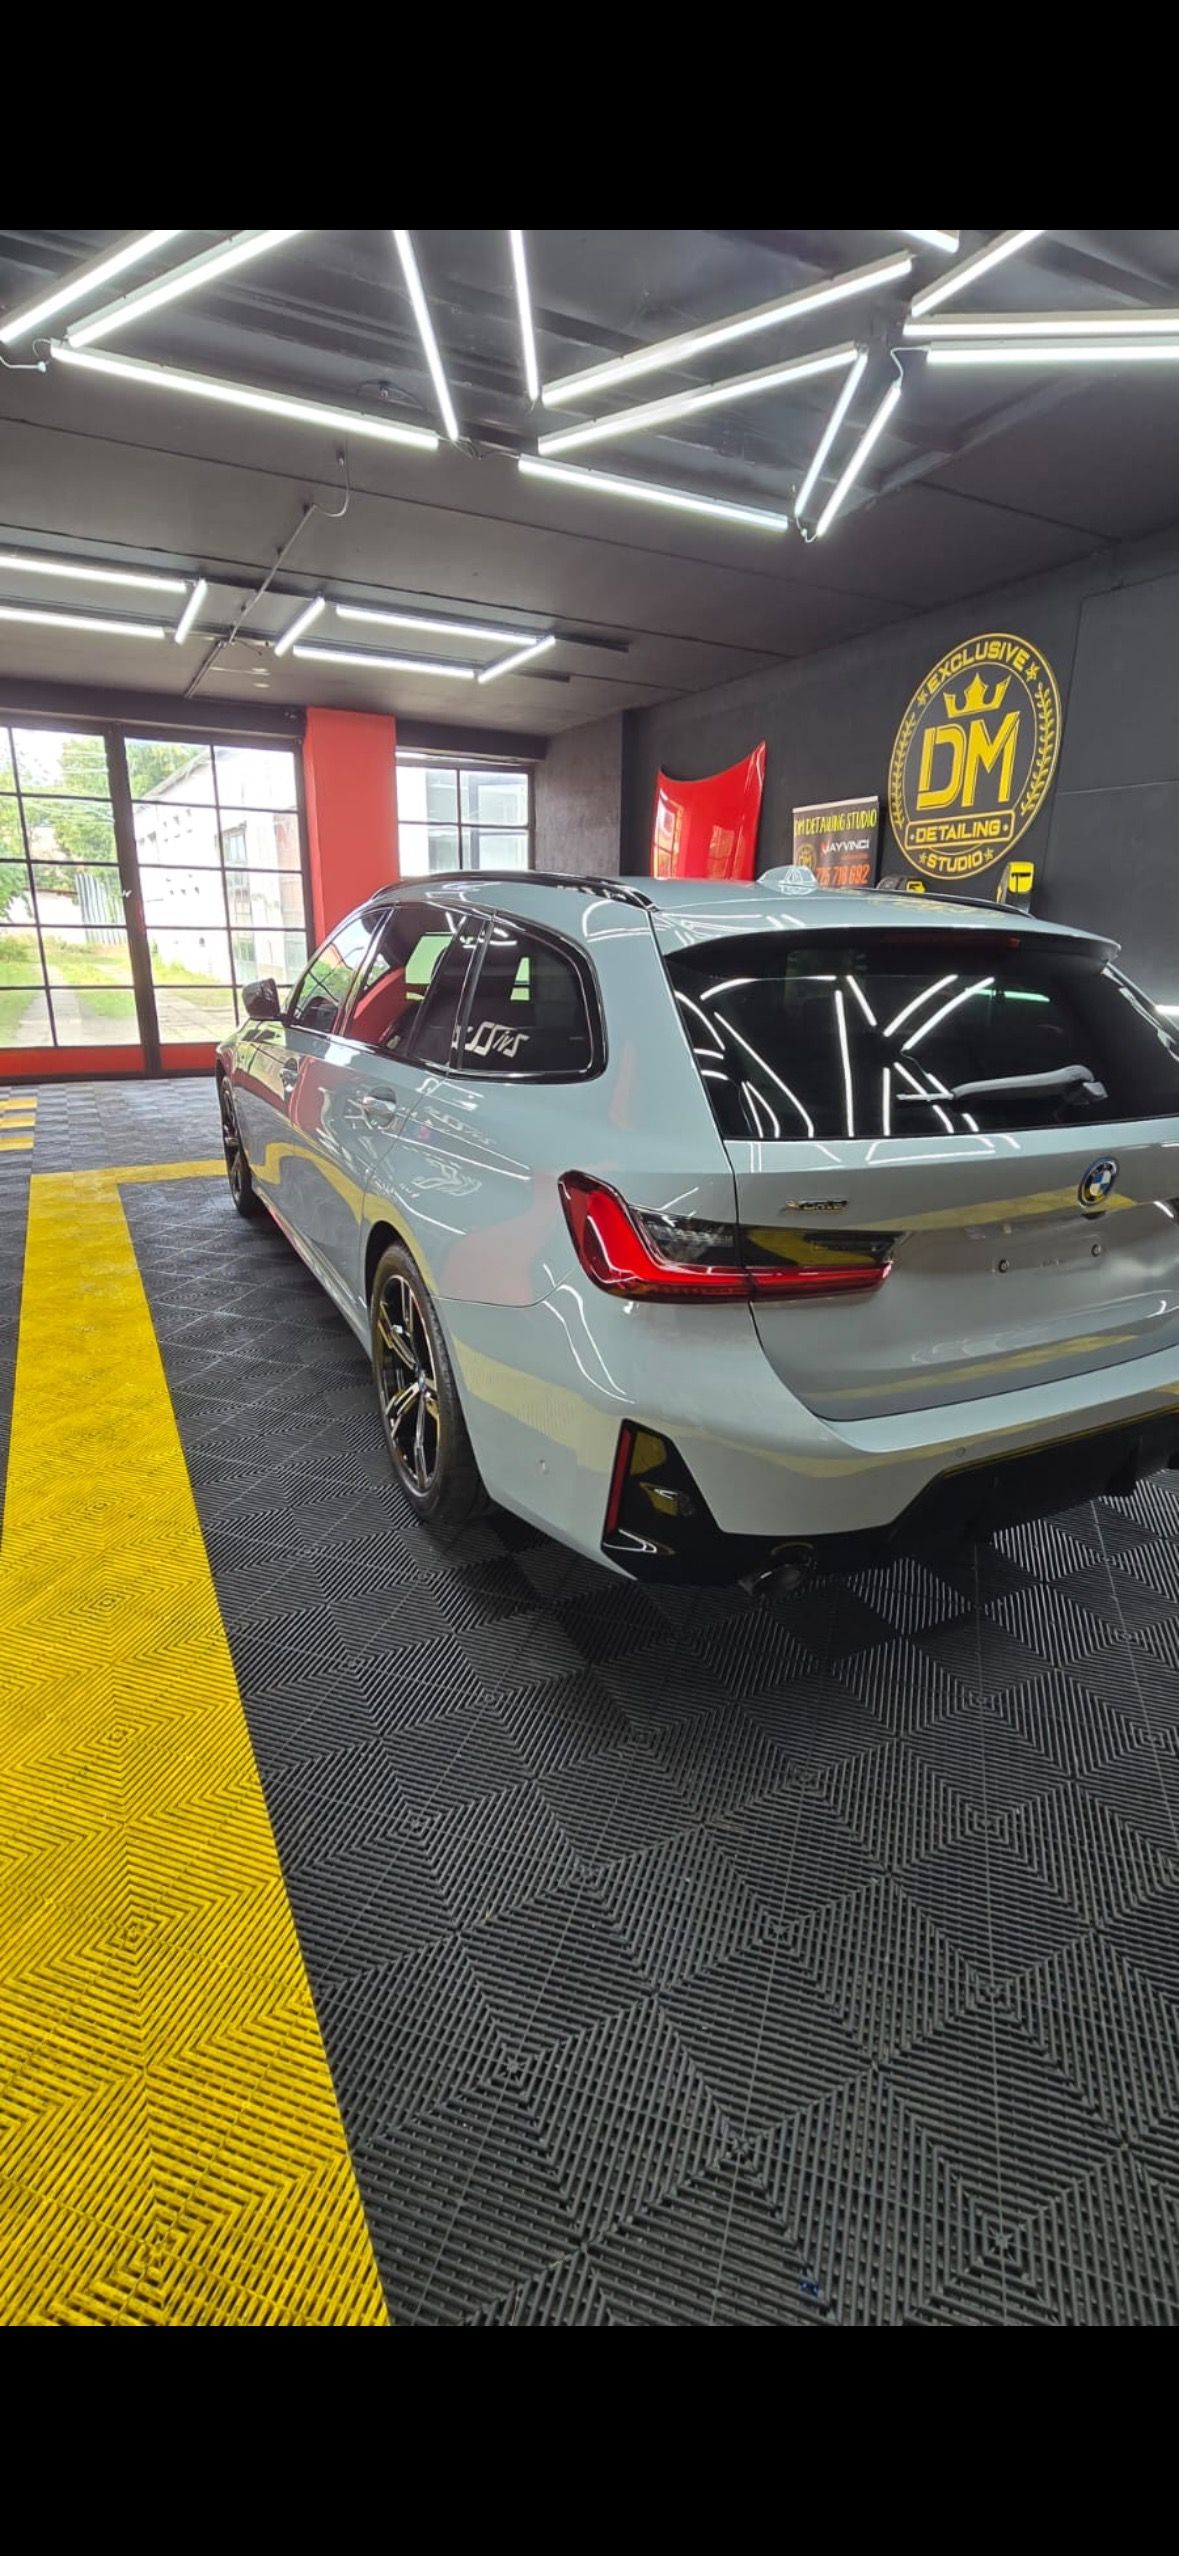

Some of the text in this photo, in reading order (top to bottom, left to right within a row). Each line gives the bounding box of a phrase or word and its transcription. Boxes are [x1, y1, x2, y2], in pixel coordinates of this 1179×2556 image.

[927, 640, 1030, 694] EXCLUSIVE
[916, 710, 1021, 811] DM
[806, 814, 845, 835] DETAILING
[847, 809, 877, 831] STUDIO
[915, 818, 1001, 843] DETAILING
[927, 849, 983, 872] STUDIO
